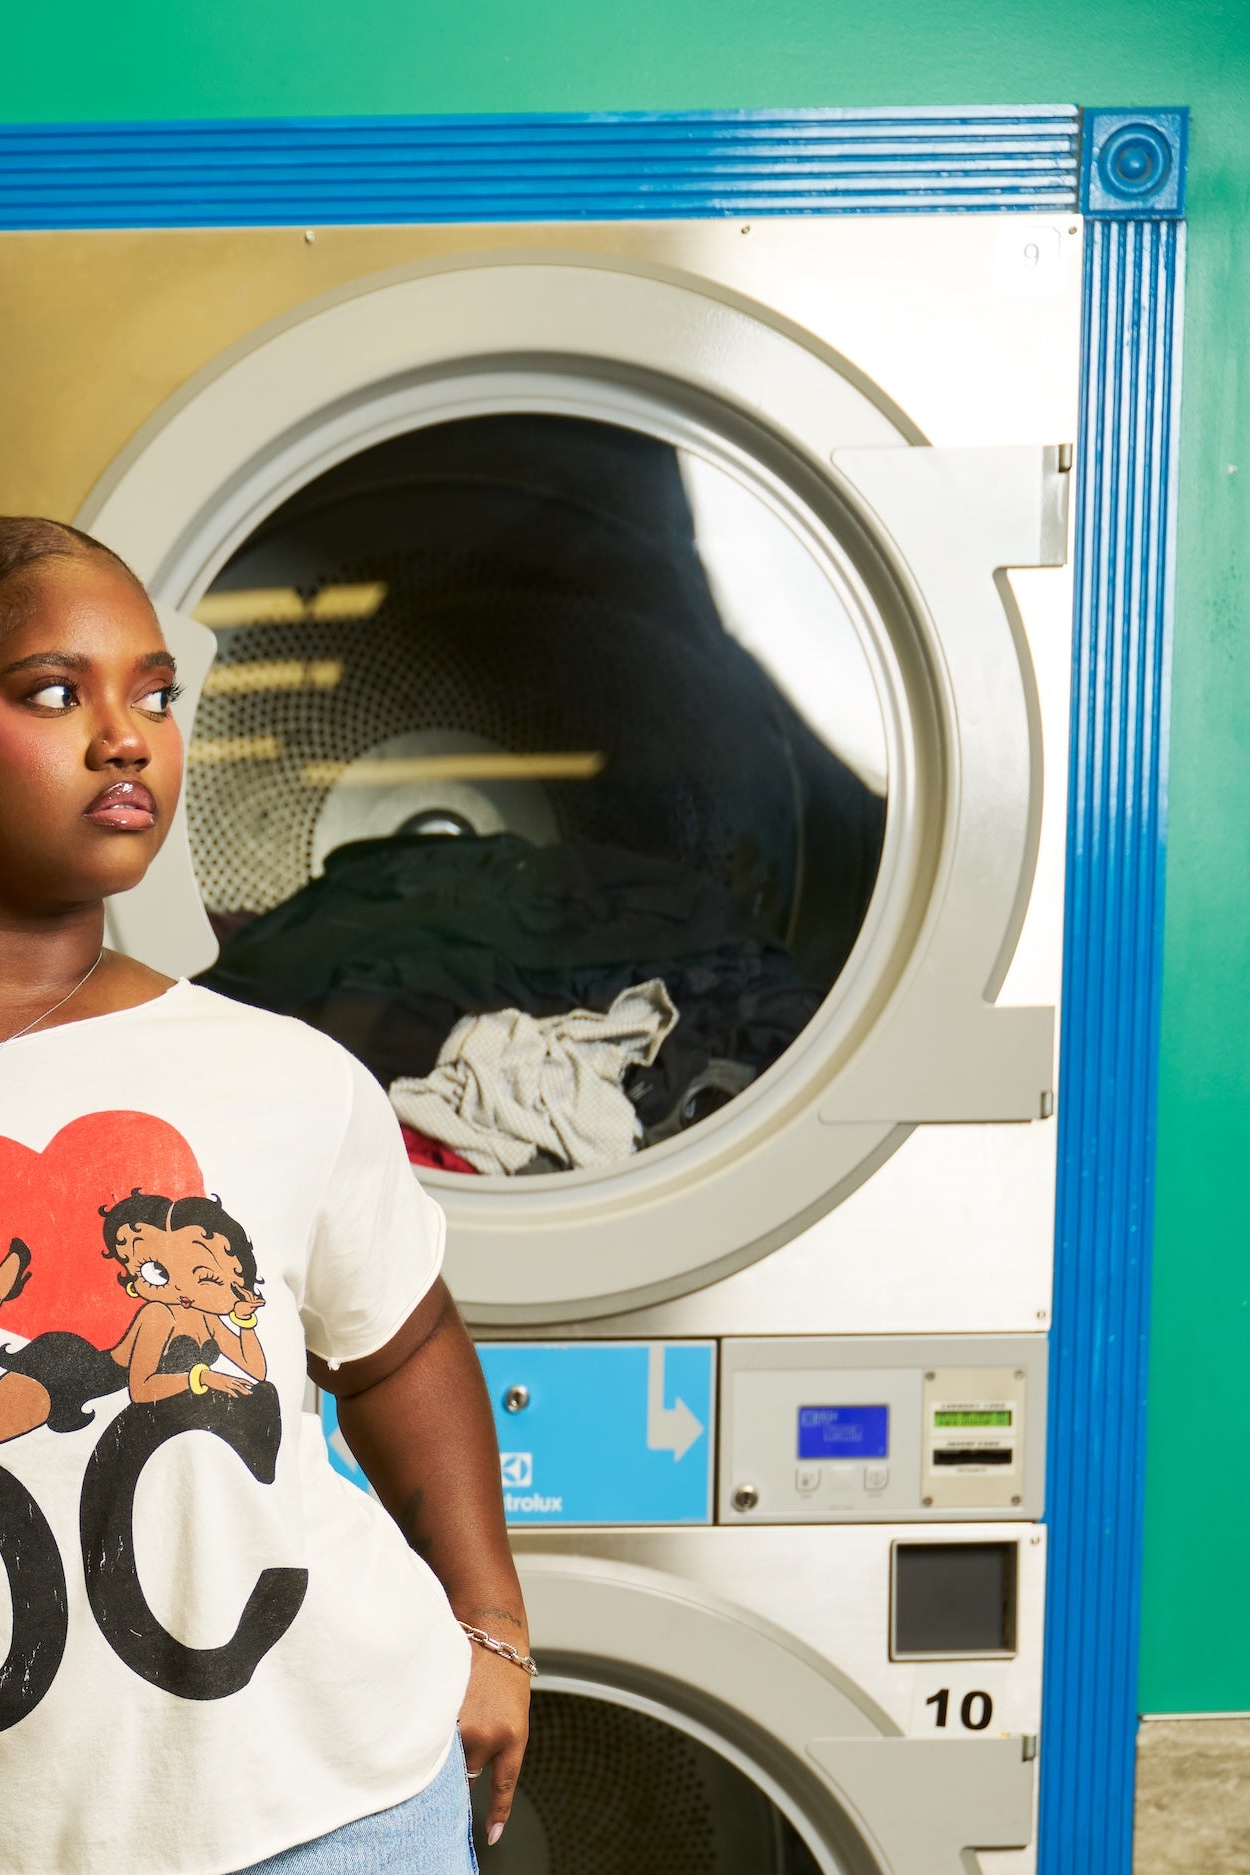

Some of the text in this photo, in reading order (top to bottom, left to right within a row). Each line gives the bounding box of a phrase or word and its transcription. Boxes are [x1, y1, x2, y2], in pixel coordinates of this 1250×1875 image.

[1023, 242, 1040, 268] 9
[502, 1492, 564, 1513] trolux
[925, 1688, 994, 1731] 10
